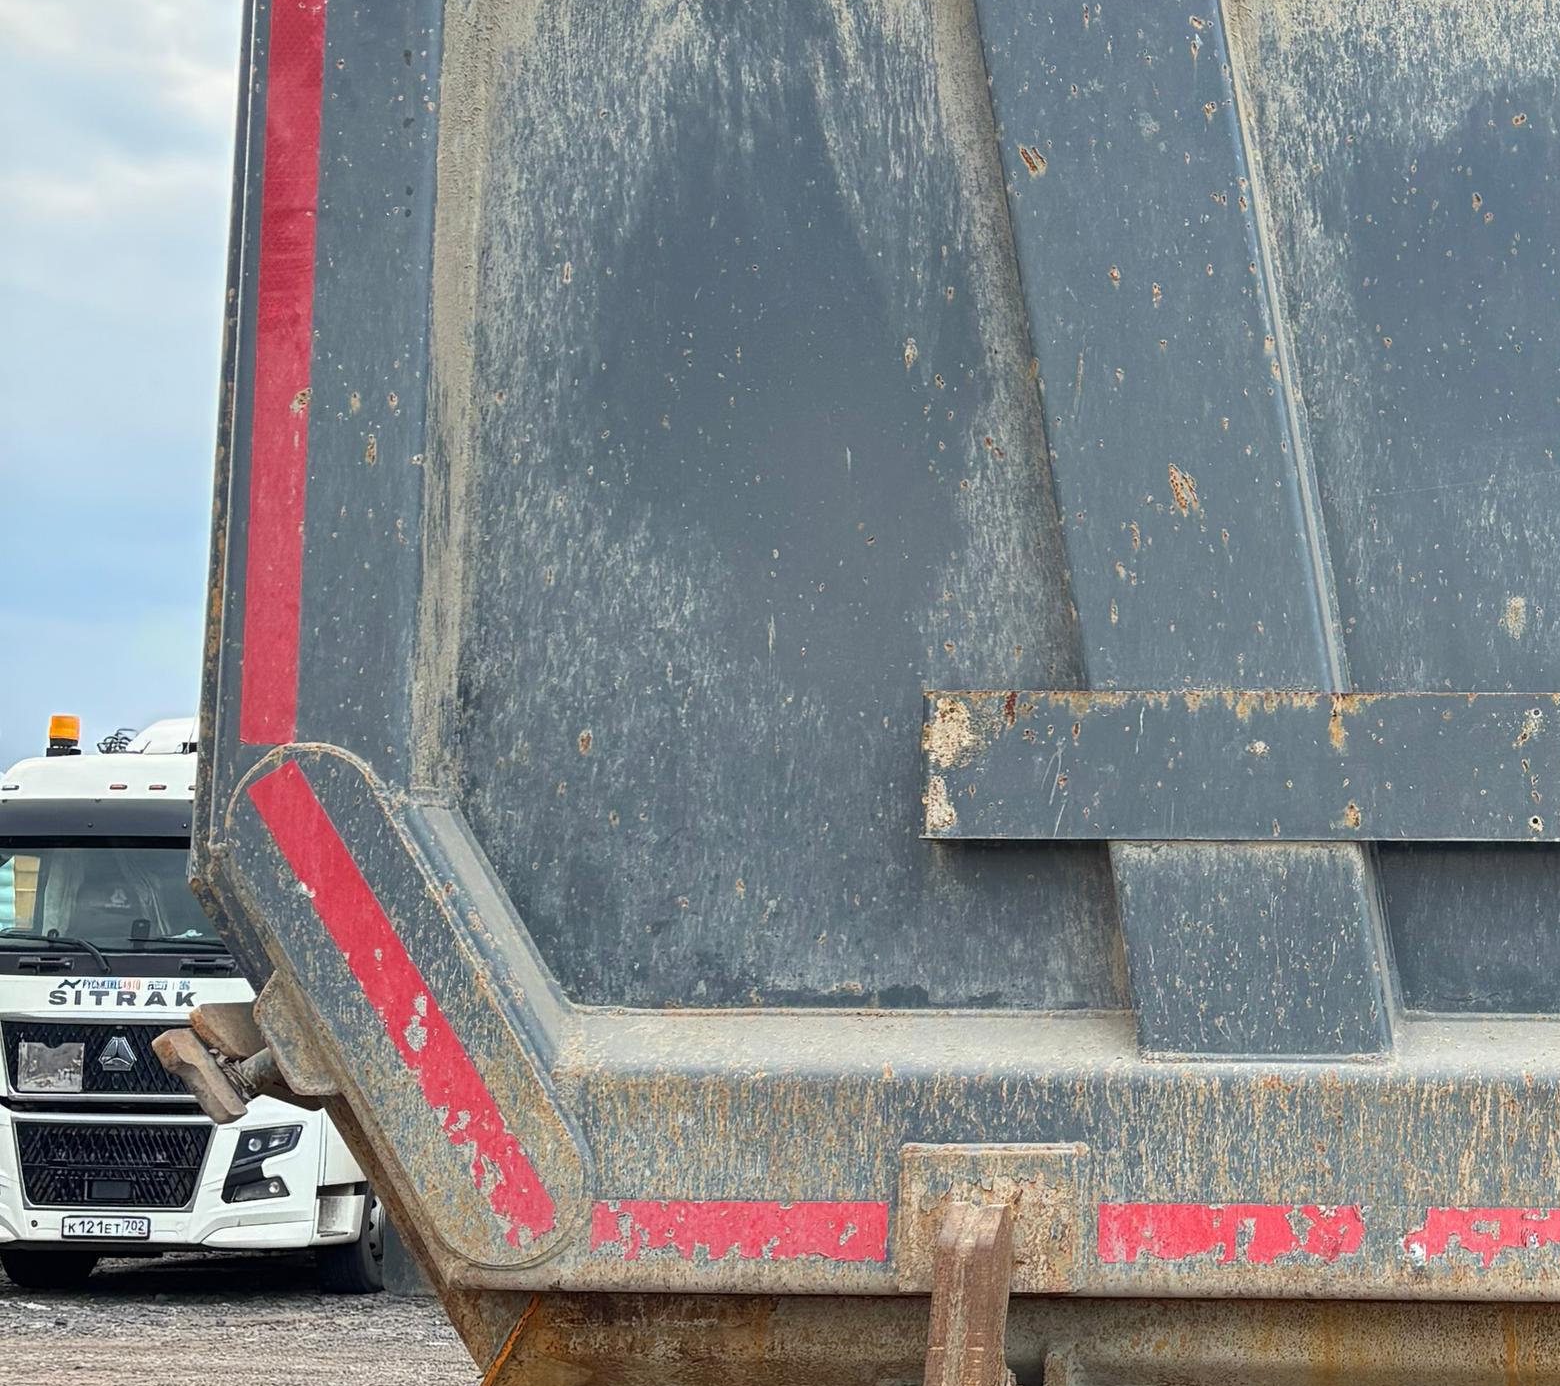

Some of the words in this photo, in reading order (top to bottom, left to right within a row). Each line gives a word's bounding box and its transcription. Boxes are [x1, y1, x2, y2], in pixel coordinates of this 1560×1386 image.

[49, 990, 197, 1007] SITRAK
[68, 1220, 121, 1234] К121ЕТ
[124, 1220, 145, 1231] 702
